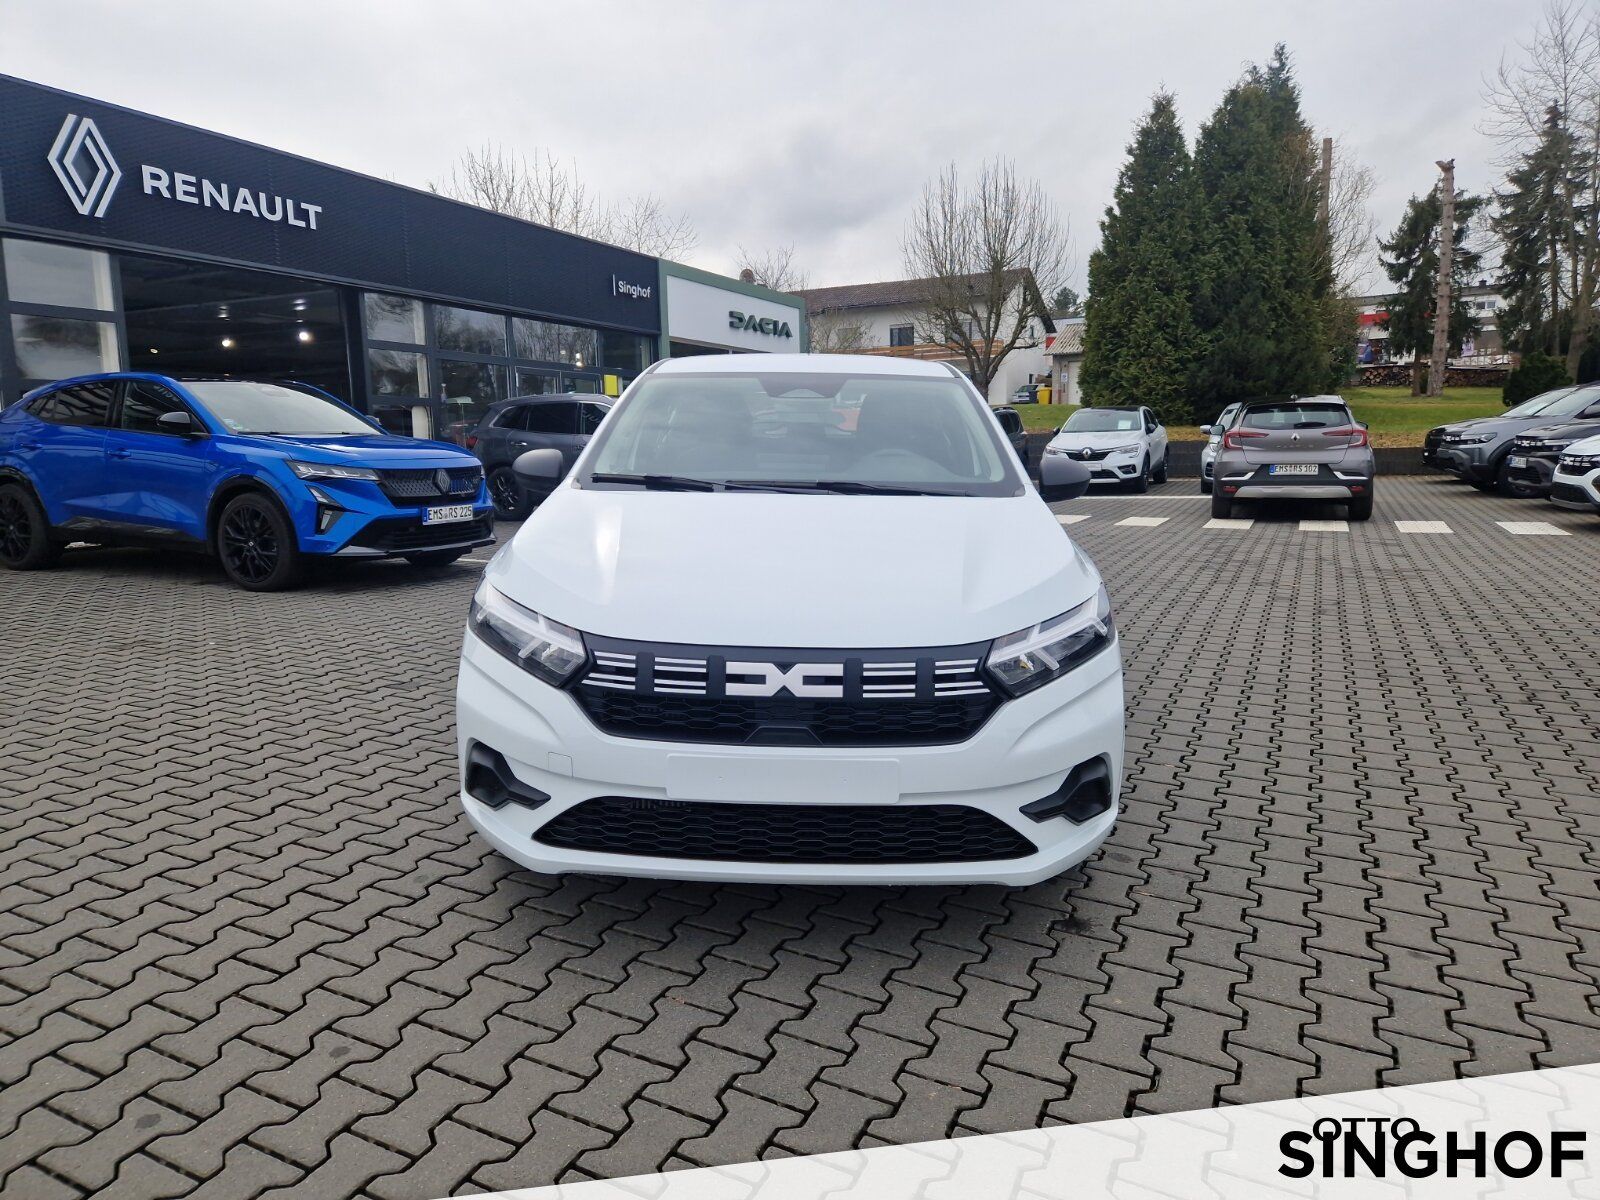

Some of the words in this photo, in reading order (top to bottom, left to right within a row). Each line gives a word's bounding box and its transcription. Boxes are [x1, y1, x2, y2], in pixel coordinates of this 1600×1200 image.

[141, 164, 322, 230] RENAULT
[618, 280, 651, 299] Singhof
[728, 310, 793, 338] DACIA
[427, 508, 443, 521] EMS
[448, 507, 458, 519] RS
[459, 506, 472, 518] 225
